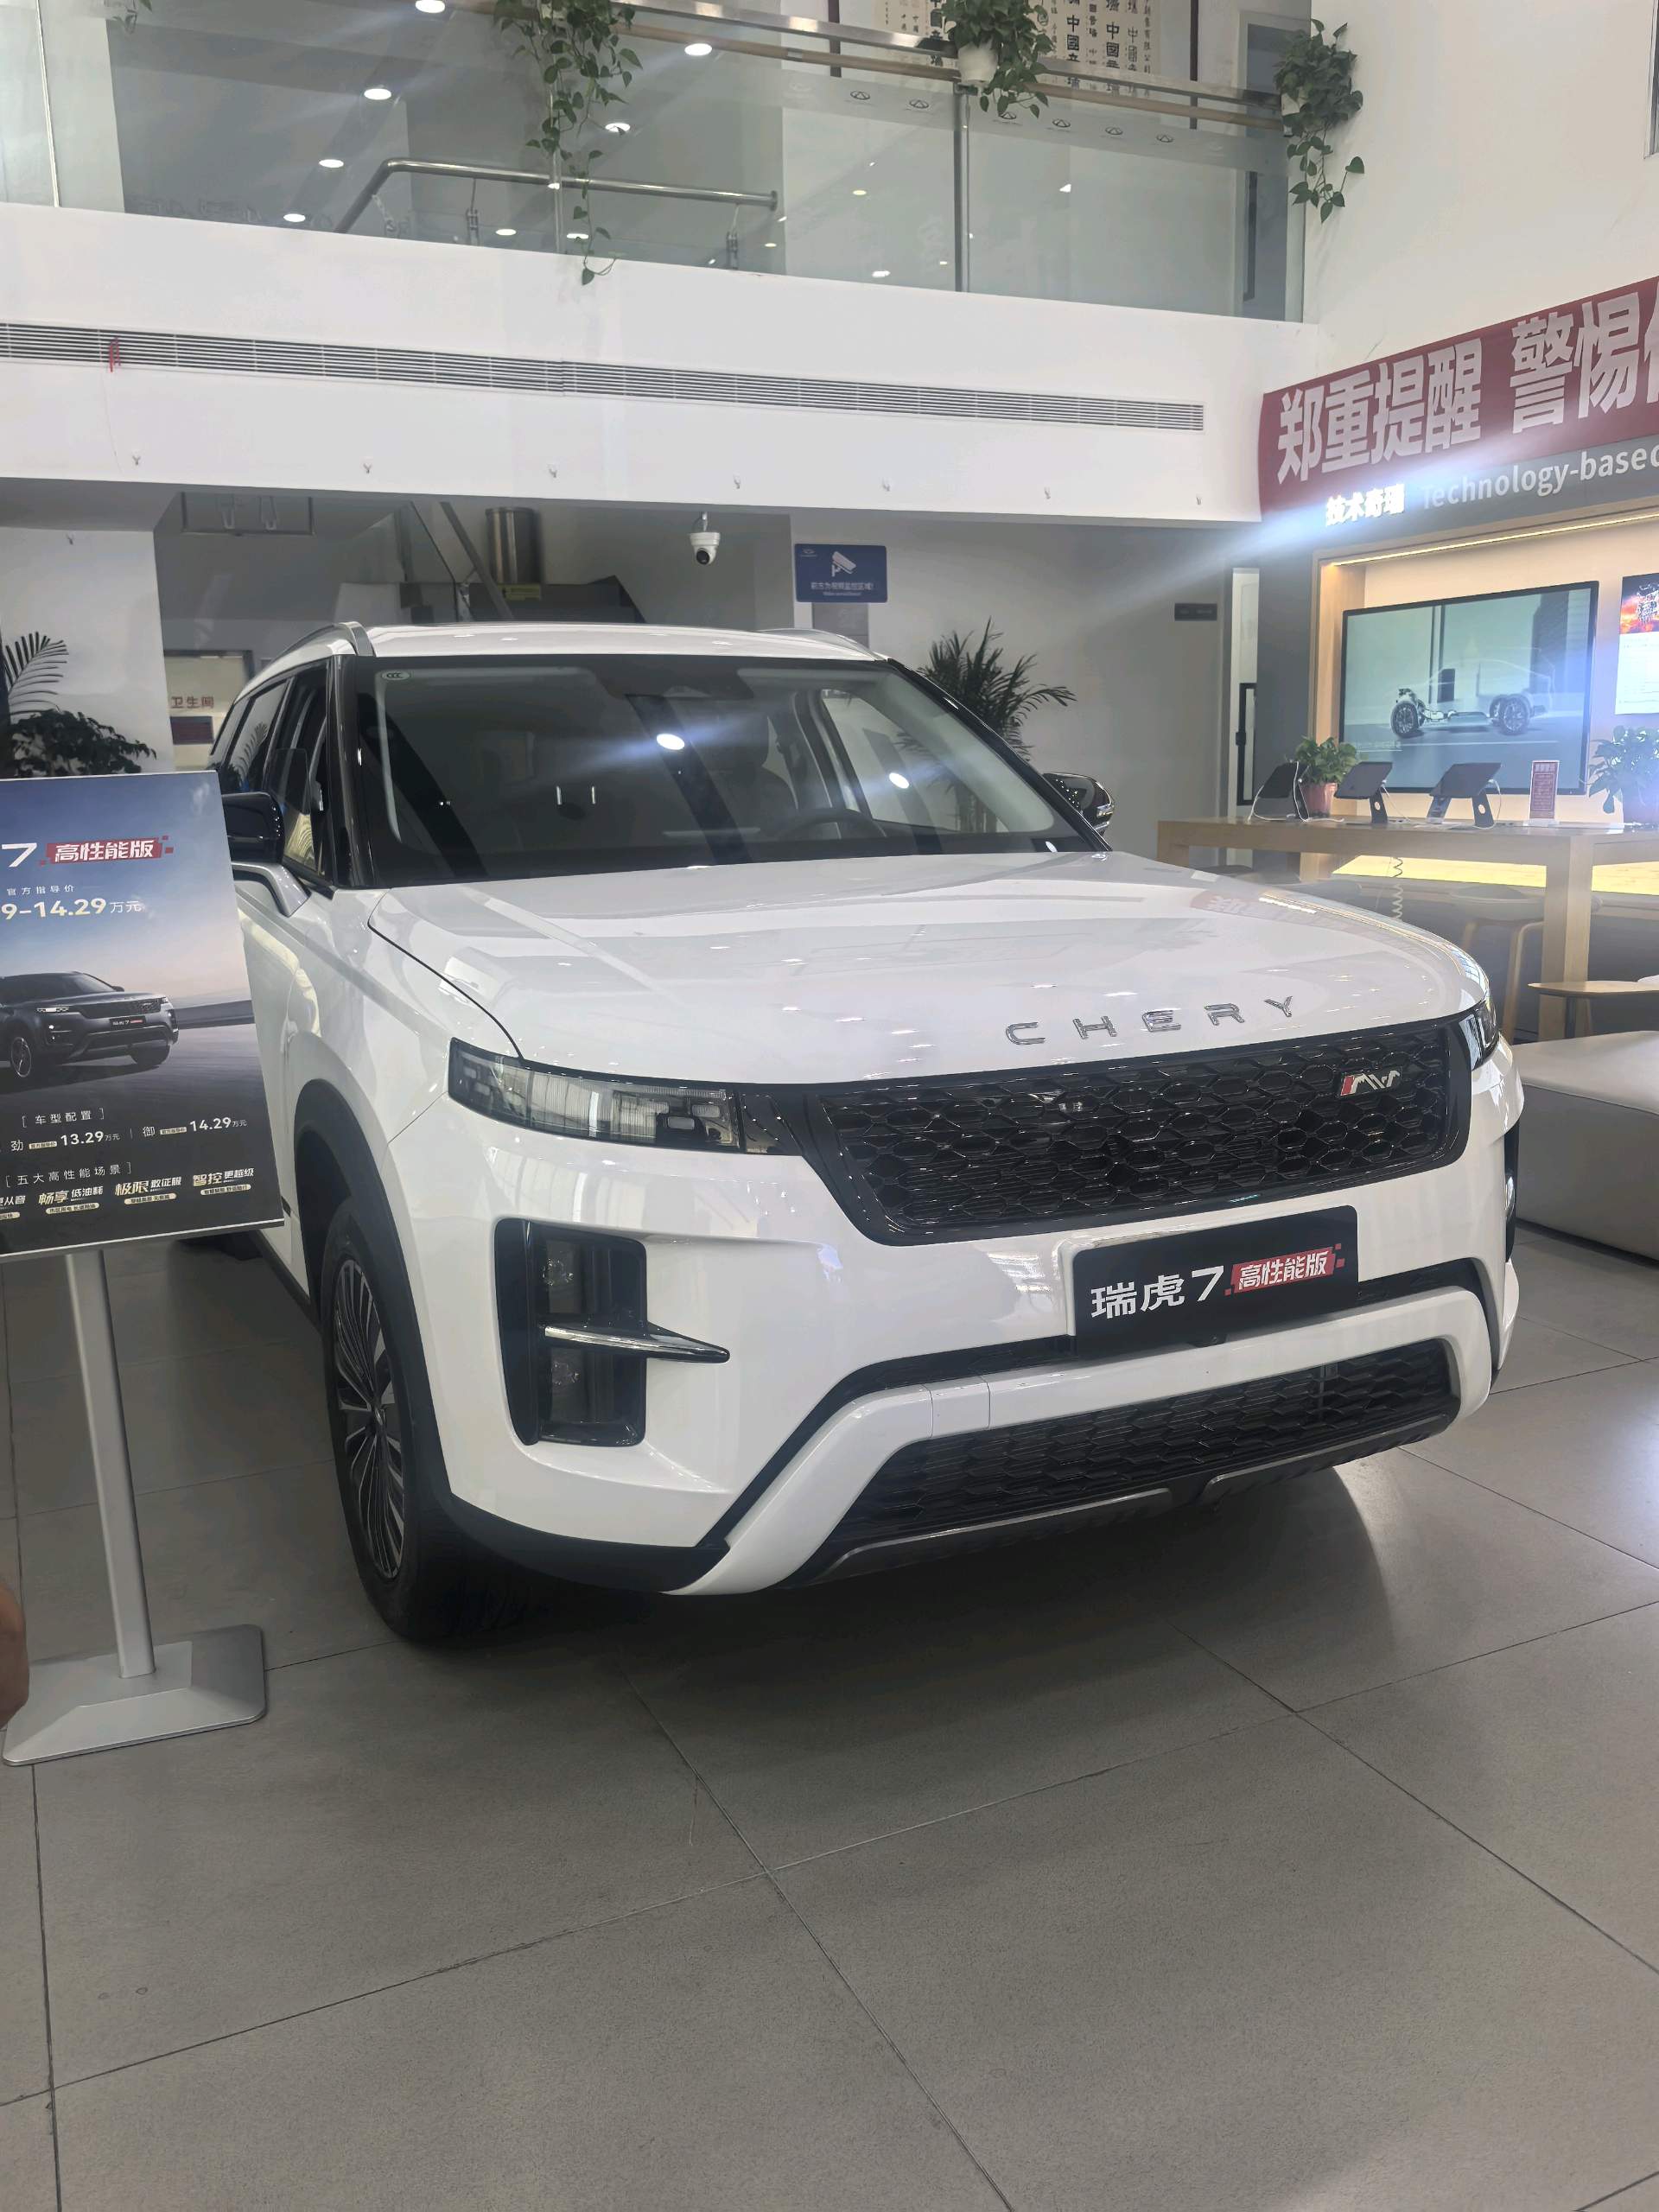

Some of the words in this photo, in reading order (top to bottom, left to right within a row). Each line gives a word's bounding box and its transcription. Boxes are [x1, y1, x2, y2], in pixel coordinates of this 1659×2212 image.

[1276, 338, 1483, 484] 郑重提醒
[170, 696, 214, 709] 卫生间
[2, 842, 37, 868] 7
[54, 840, 155, 862] 高性能版
[7, 884, 74, 896] 官方指导价
[1005, 995, 1294, 1046] CHERY
[10, 1140, 24, 1152] 劲
[1090, 1265, 1225, 1319] 瑞虎7
[1238, 1250, 1330, 1290] 高性能版
